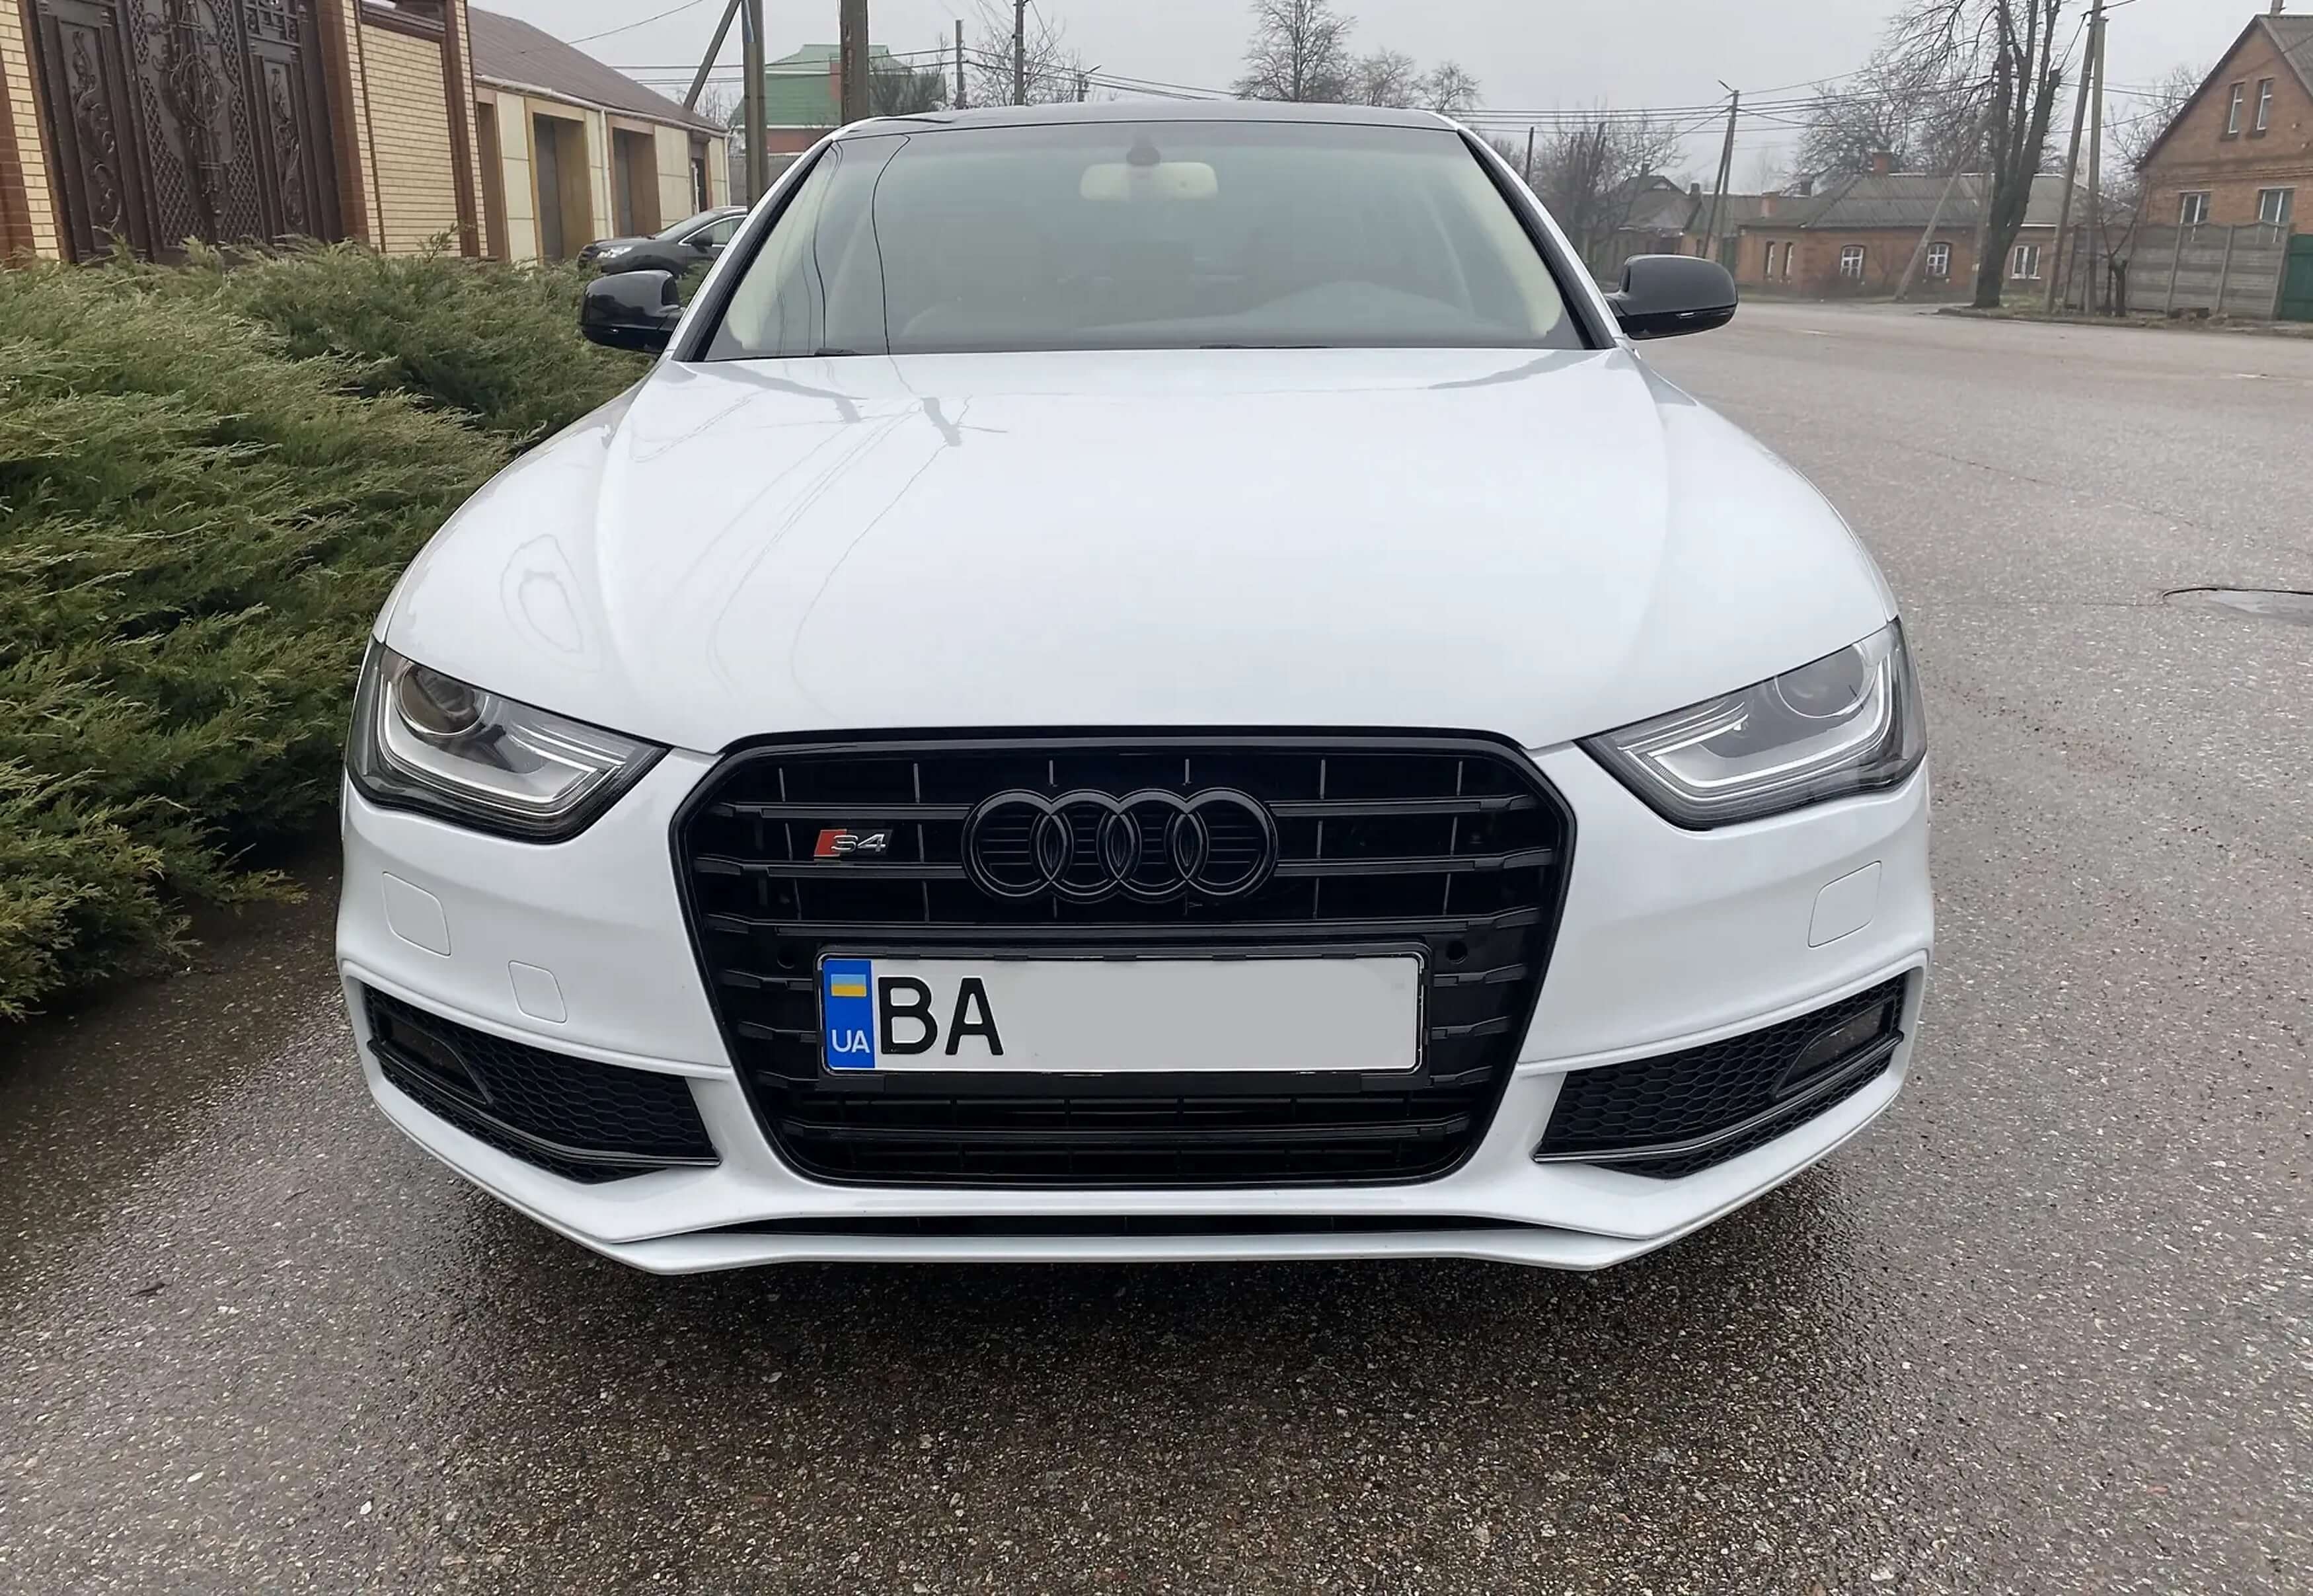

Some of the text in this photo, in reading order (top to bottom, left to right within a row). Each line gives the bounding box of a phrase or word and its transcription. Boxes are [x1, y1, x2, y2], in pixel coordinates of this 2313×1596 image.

[831, 833, 886, 853] S4
[878, 976, 1004, 1055] BA
[831, 1029, 870, 1053] UA
